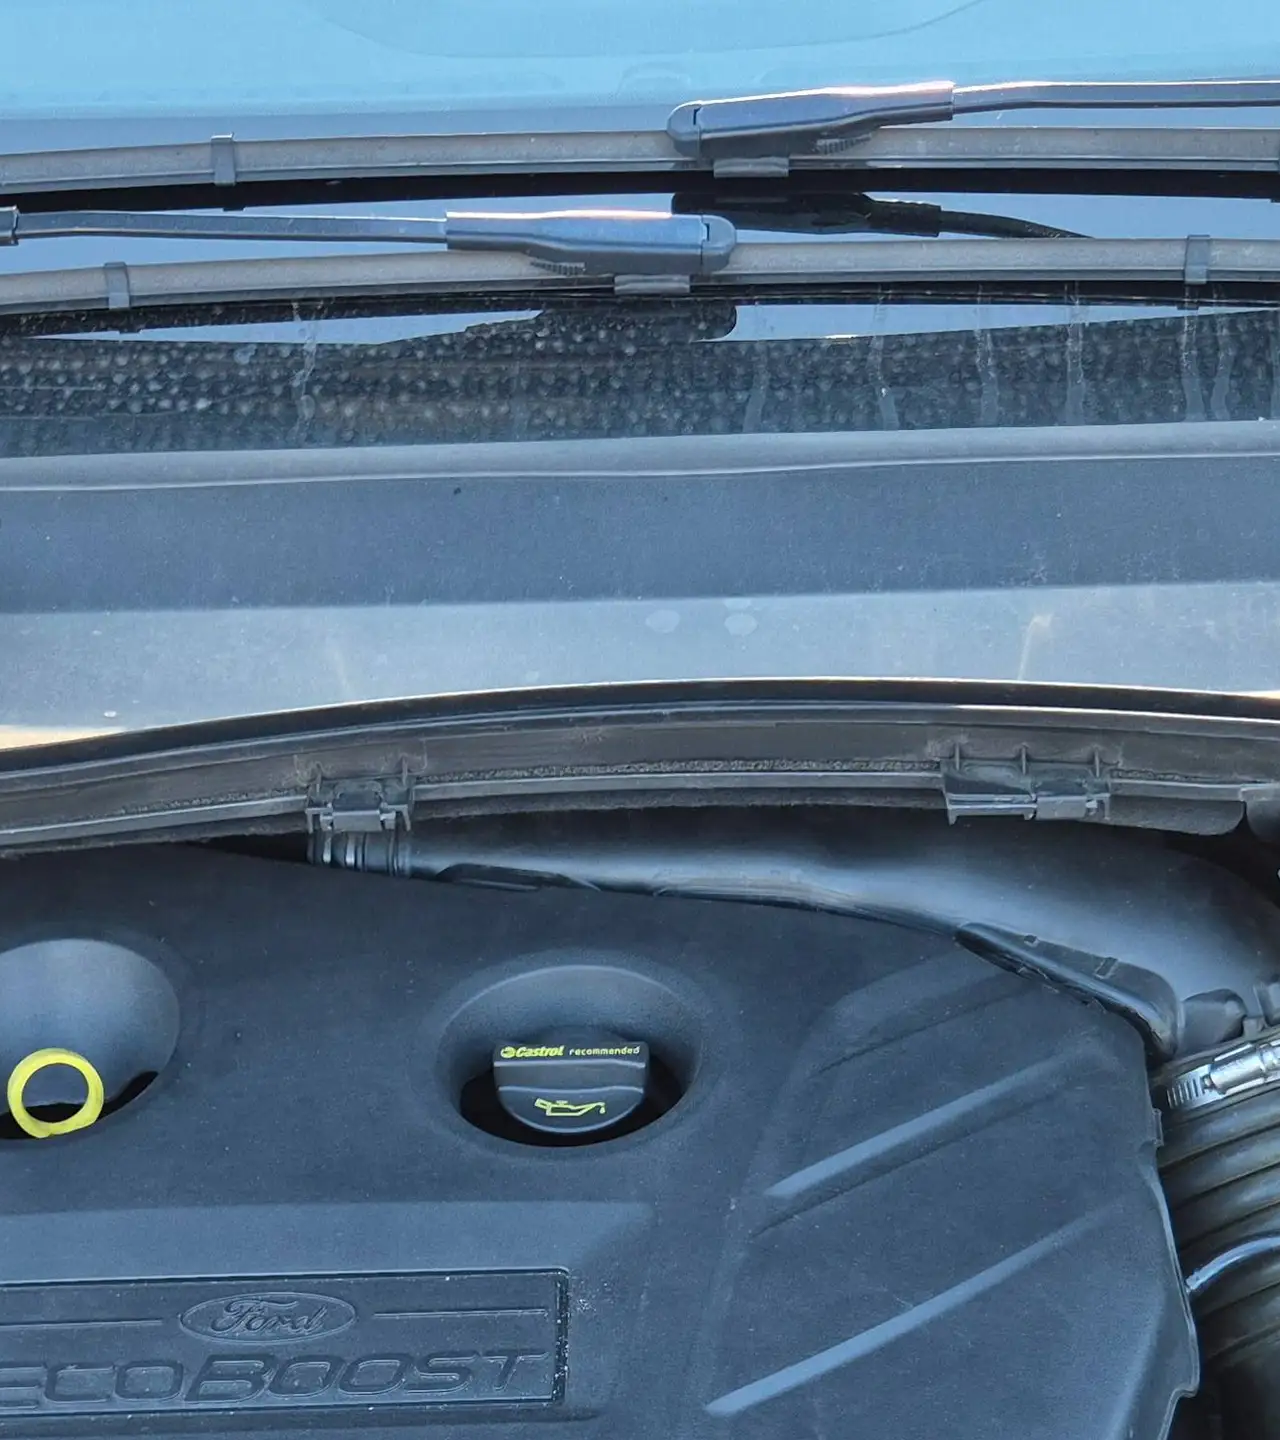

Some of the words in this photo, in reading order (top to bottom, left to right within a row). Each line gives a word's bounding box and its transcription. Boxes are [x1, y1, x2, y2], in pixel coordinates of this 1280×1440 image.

[515, 1045, 564, 1058] Castrol
[569, 1046, 640, 1056] recommended
[210, 1296, 328, 1336] Ford
